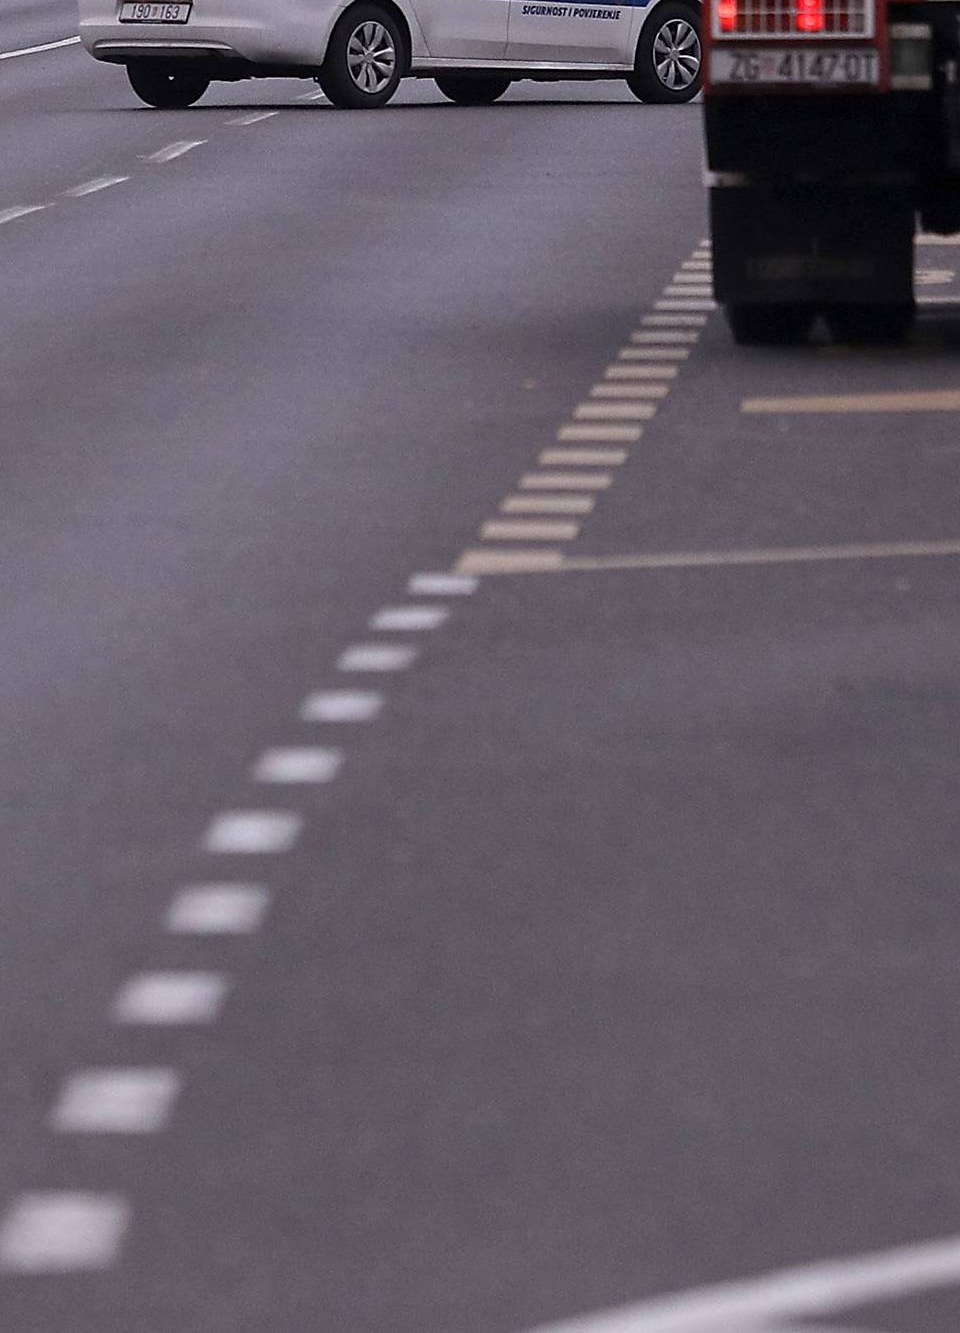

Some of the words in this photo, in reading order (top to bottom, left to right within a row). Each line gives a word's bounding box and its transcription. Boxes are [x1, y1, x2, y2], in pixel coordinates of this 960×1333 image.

[160, 5, 180, 19] 163
[522, 6, 567, 17] SIGURNOST
[573, 8, 621, 20] POVJERENJE
